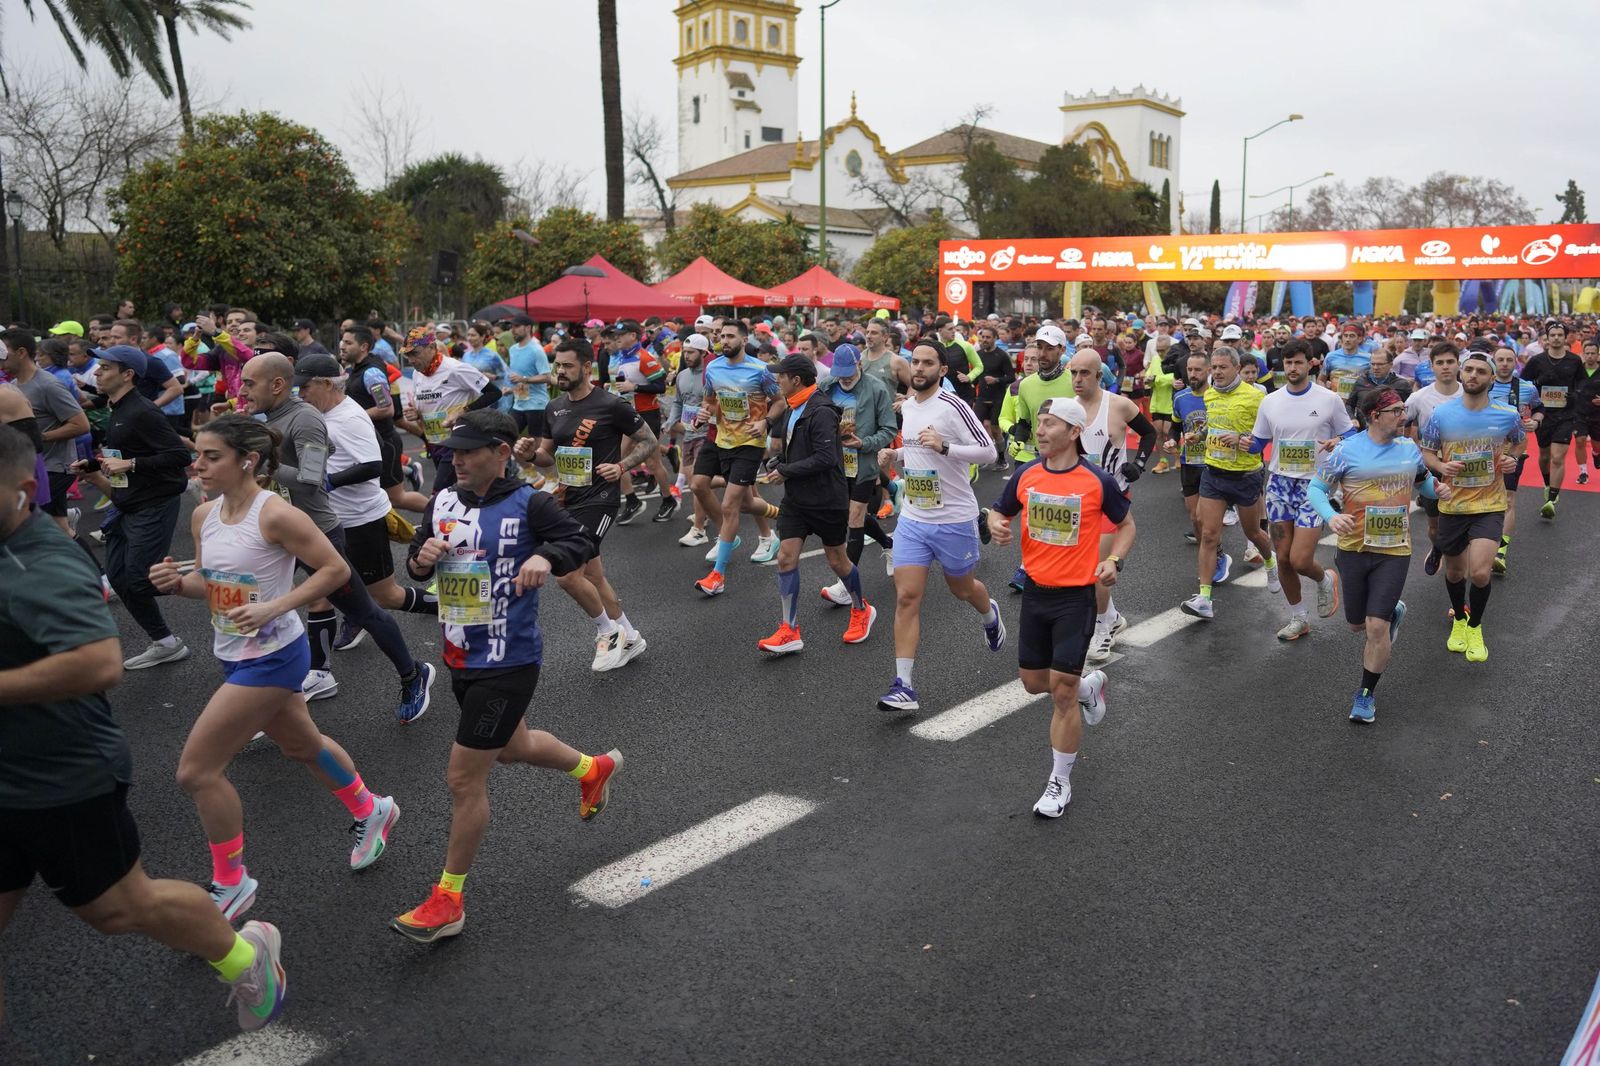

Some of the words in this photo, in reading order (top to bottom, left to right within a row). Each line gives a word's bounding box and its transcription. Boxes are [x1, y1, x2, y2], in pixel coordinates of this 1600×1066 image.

[1351, 245, 1405, 263] HOKA
[721, 398, 743, 409] 10382
[1281, 448, 1310, 459] 12235
[557, 457, 586, 470] 11965
[906, 479, 934, 492] 13359
[1031, 505, 1071, 525] 11049
[1368, 516, 1404, 530] 10945
[207, 582, 244, 607] 7134
[439, 577, 480, 598] 12270
[486, 517, 521, 664] ELECSER
